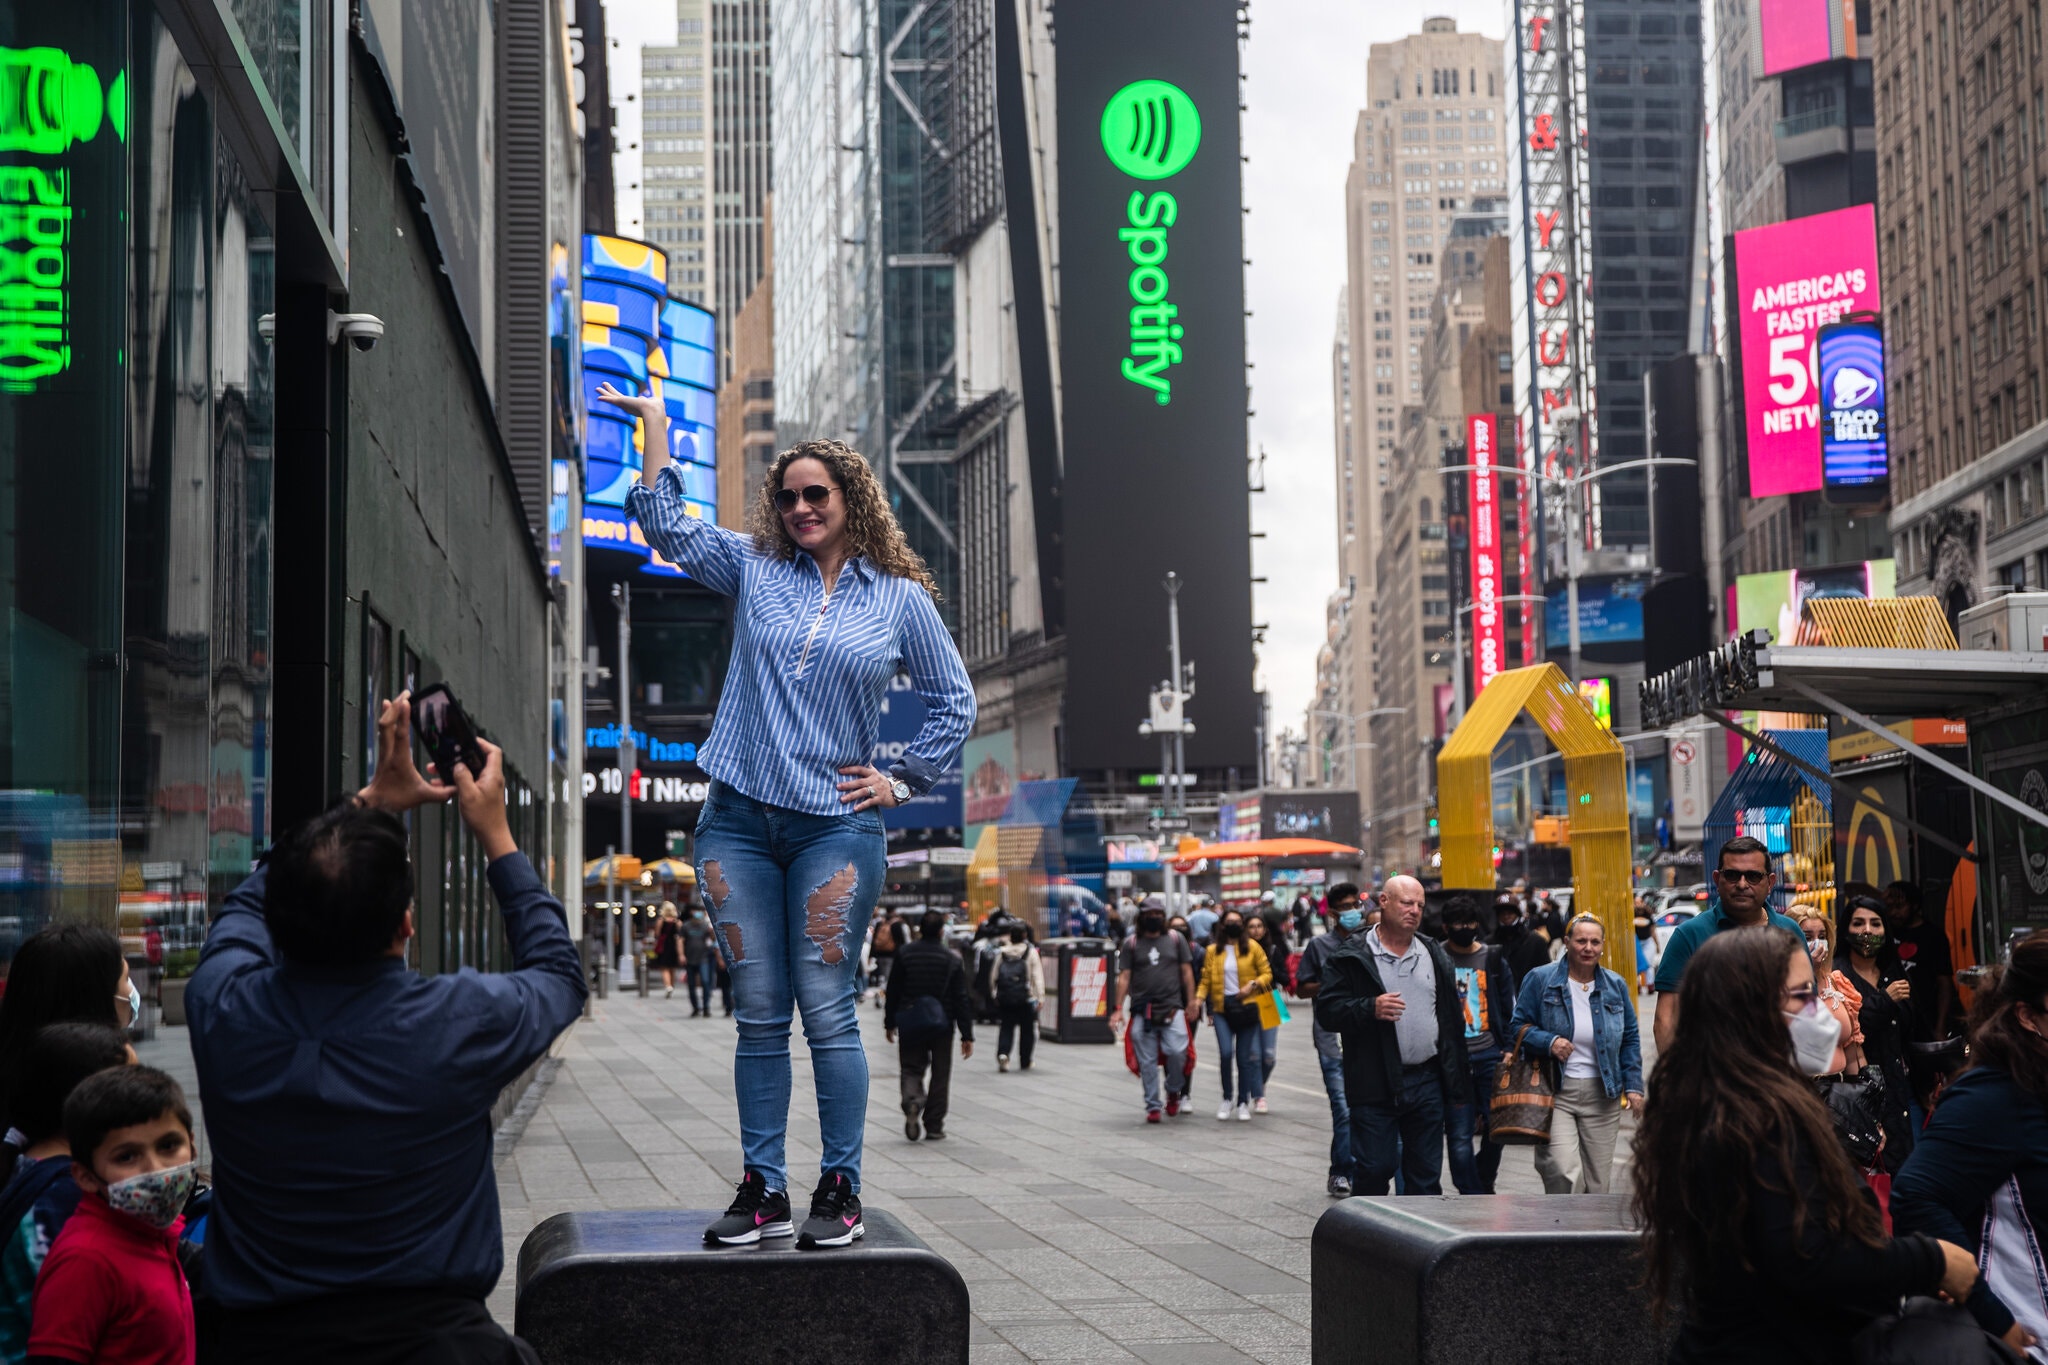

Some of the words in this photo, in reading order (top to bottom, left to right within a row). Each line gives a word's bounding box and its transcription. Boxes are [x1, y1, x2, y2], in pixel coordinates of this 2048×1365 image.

[1118, 190, 1184, 396] Spotify
[1752, 268, 1867, 312] AMERICA'S
[1766, 298, 1855, 336] FASTEST
[1830, 409, 1880, 427] TACO
[1834, 424, 1881, 441] BELL
[649, 737, 697, 762] has
[599, 768, 622, 794] 10
